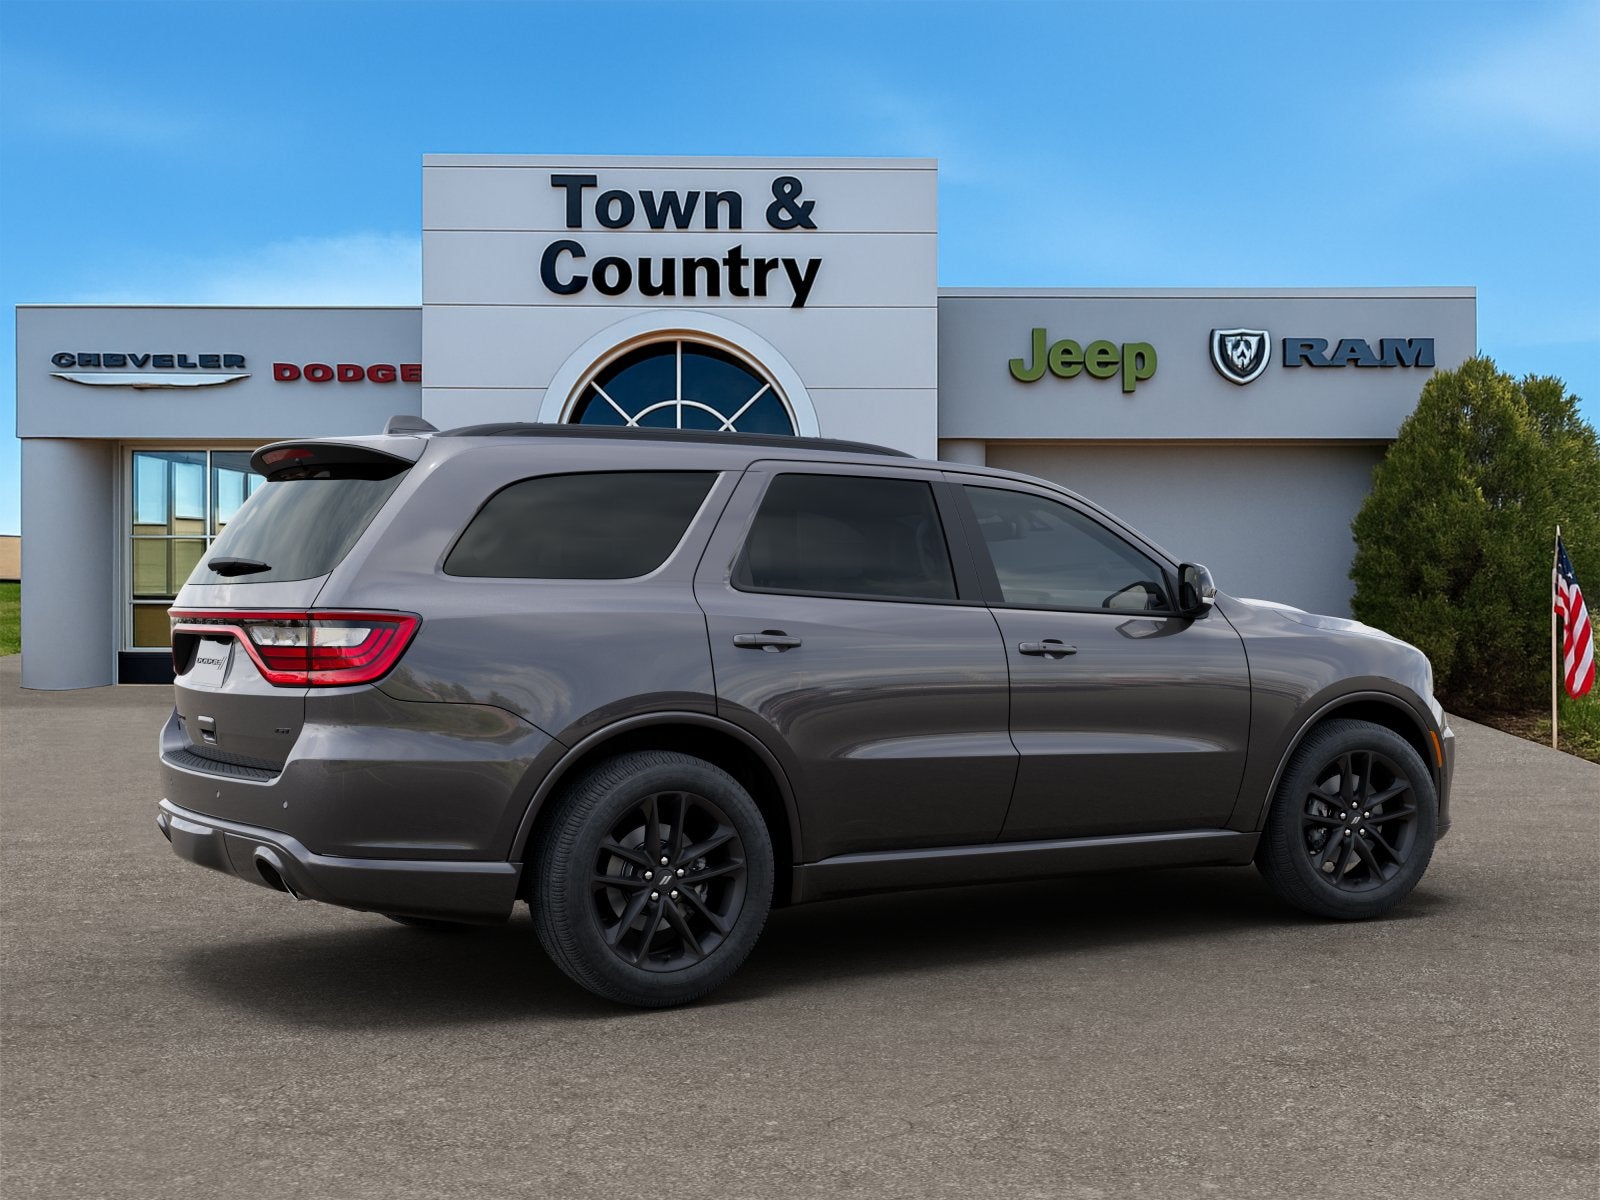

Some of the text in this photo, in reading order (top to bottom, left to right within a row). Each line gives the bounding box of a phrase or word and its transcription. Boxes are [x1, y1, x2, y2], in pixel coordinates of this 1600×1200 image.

[551, 174, 817, 229] Town &
[540, 239, 822, 308] Country
[273, 362, 422, 383] DODGE
[1009, 328, 1157, 393] Jeep
[1282, 337, 1435, 368] RAM
